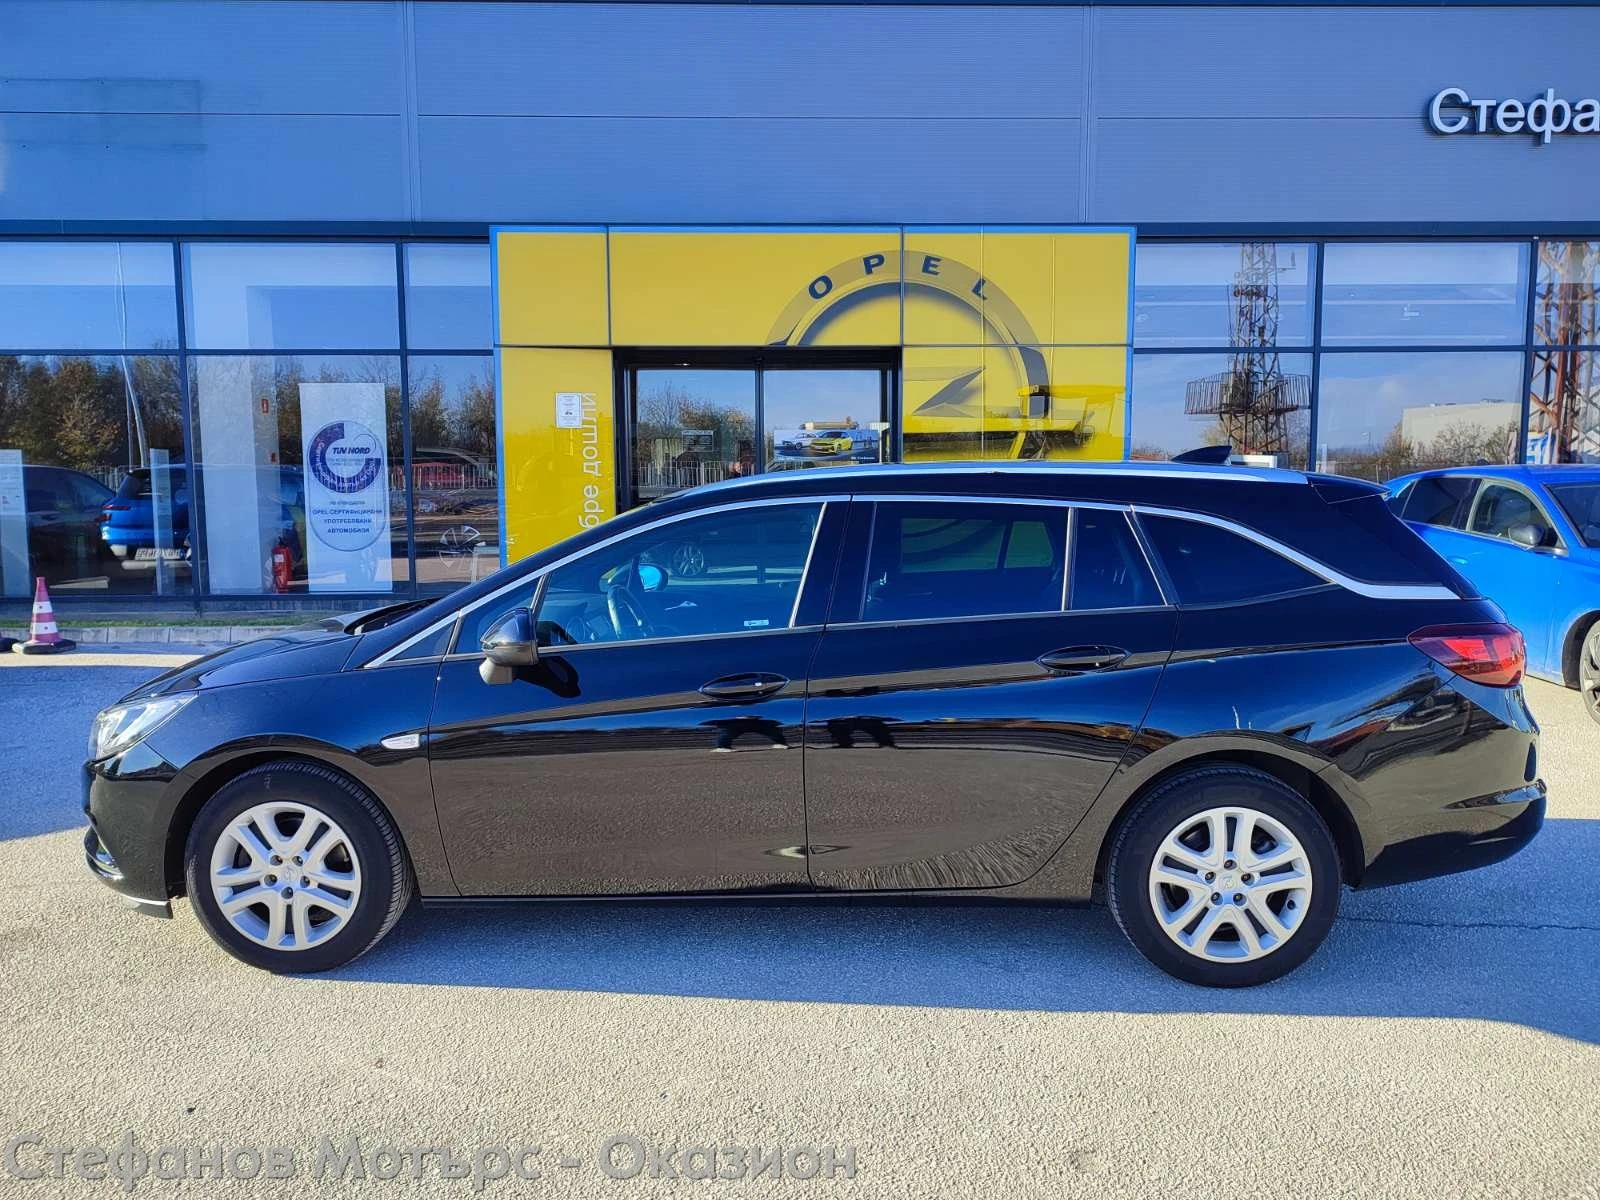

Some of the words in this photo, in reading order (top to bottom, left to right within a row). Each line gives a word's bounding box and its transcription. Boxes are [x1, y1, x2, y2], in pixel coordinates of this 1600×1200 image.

[1430, 87, 1600, 144] Стефа
[808, 253, 988, 300] OPEL
[582, 392, 602, 477] дошли
